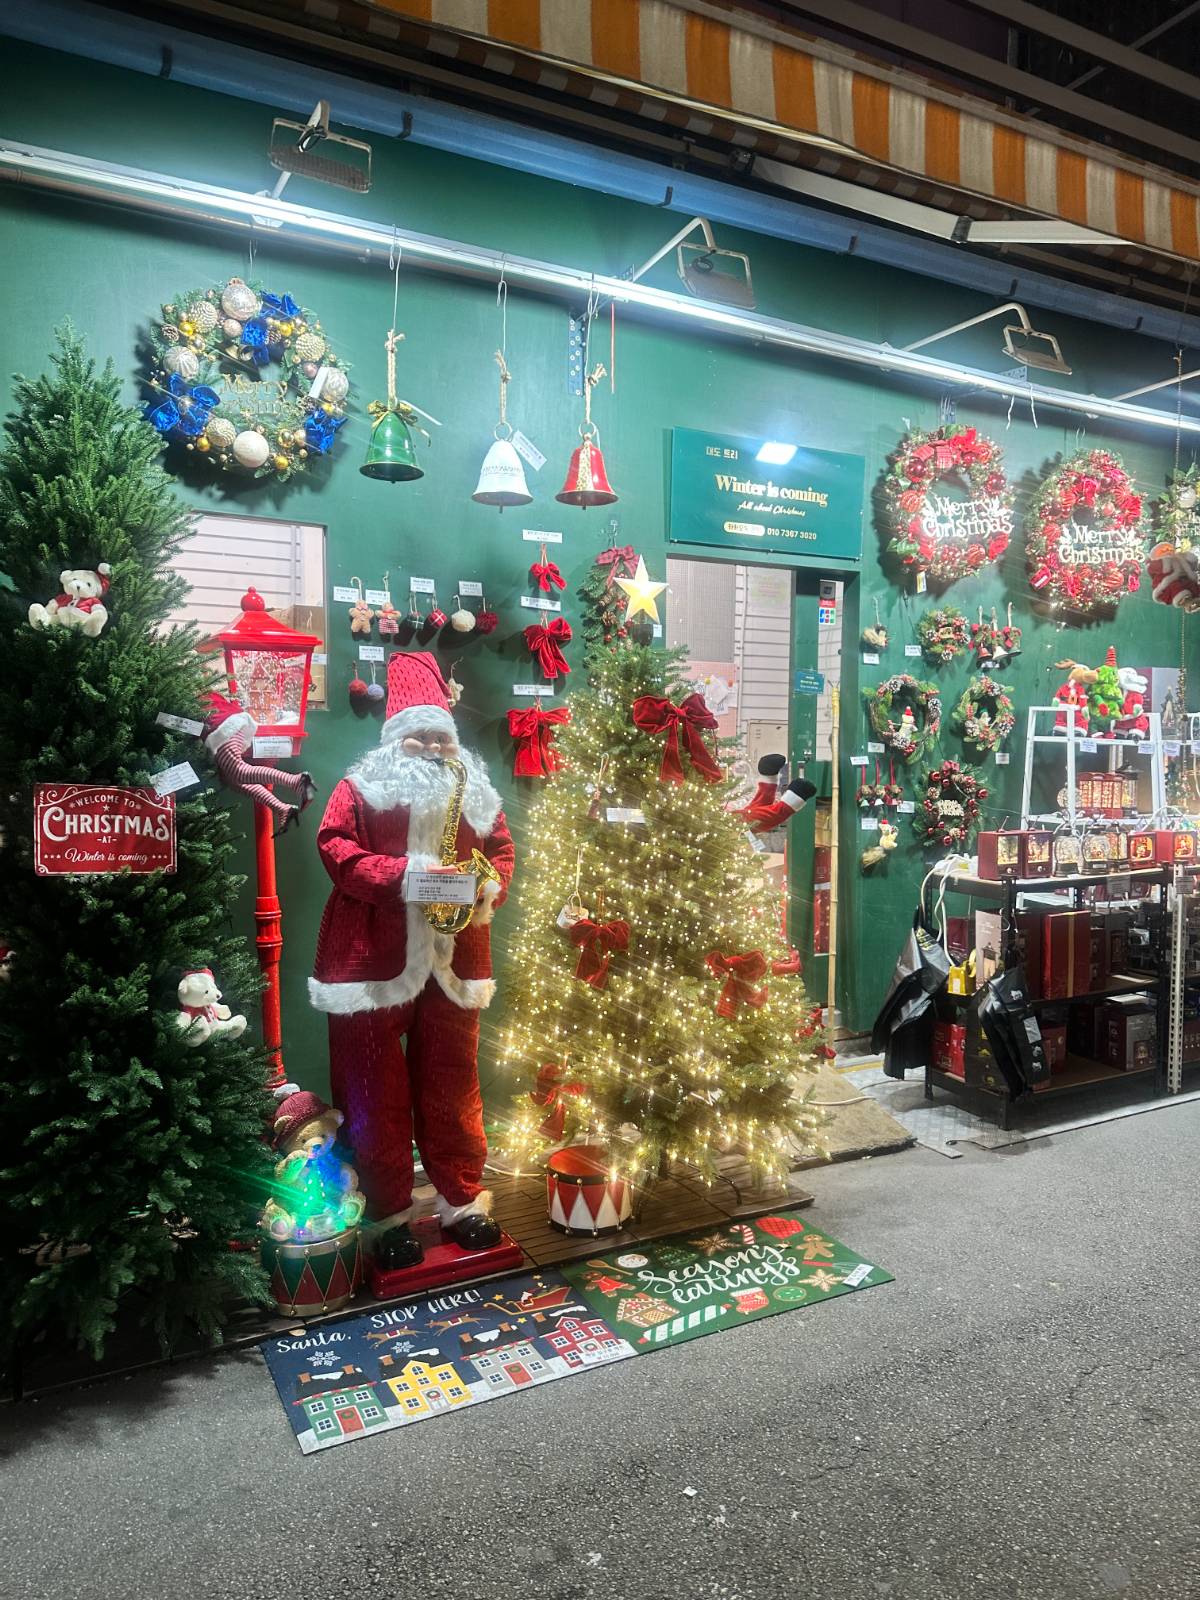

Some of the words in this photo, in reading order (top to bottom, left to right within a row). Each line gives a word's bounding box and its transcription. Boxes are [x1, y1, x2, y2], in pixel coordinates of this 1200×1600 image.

[715, 474, 766, 496] Winter
[766, 480, 780, 498] is
[780, 487, 828, 507] coming
[737, 500, 754, 511] All
[753, 503, 773, 513] about
[773, 505, 806, 517] Christmas
[934, 496, 992, 518] Merry
[767, 527, 780, 536] 010
[922, 515, 1015, 541] Christmas
[1072, 523, 1128, 546] Merry
[1058, 543, 1146, 566] Christmas
[75, 795, 120, 807] WELCOME
[124, 797, 136, 808] TO
[42, 806, 170, 842] CHRISTMAS
[64, 847, 105, 863] Winter
[107, 852, 115, 861] is
[118, 852, 148, 865] coming
[370, 1304, 418, 1329] STOP
[428, 1289, 484, 1314] HERE!
